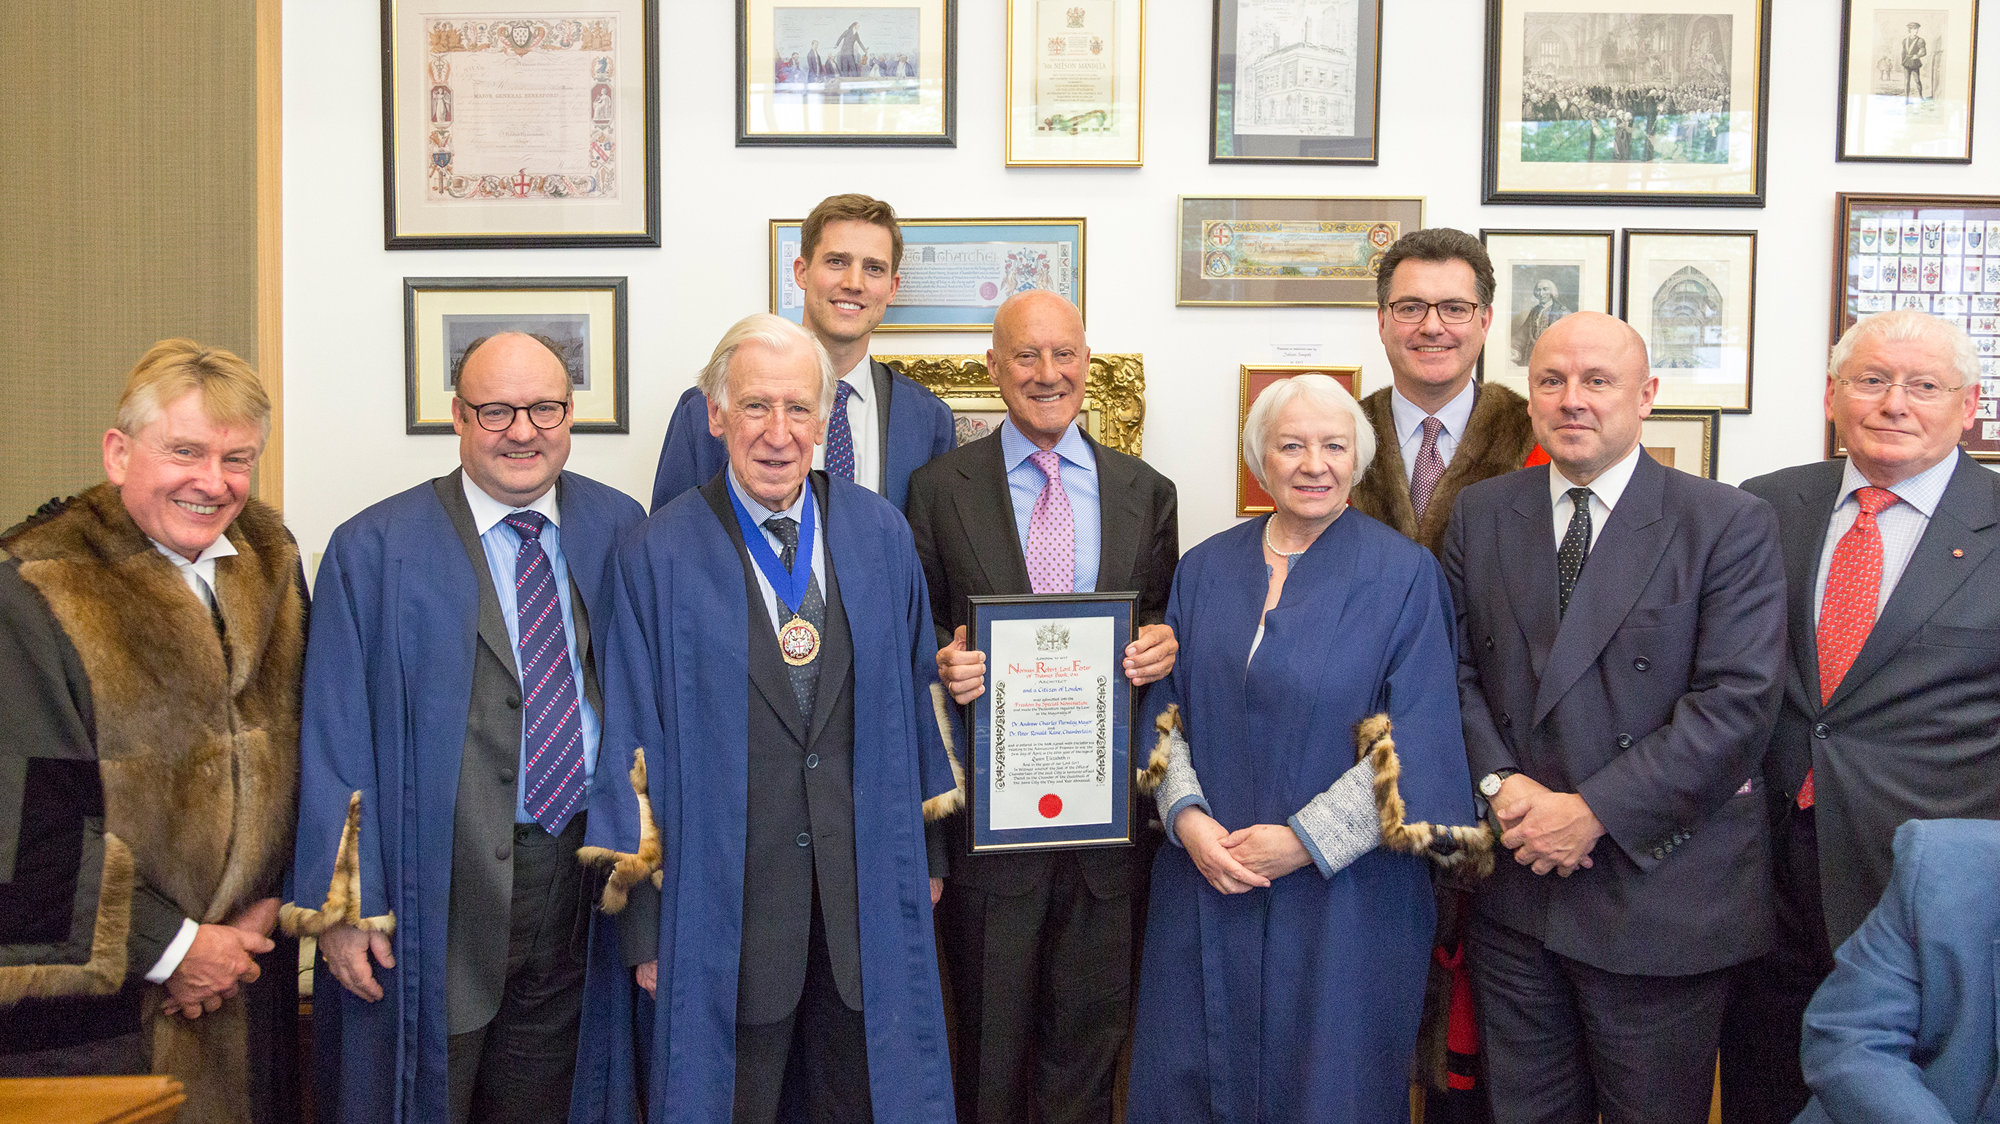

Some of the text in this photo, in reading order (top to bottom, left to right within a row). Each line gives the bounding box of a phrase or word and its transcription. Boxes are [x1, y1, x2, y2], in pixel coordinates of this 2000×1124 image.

[1008, 663, 1034, 674] Norman
[1036, 661, 1057, 673] Robert
[1072, 660, 1091, 671] Foster
